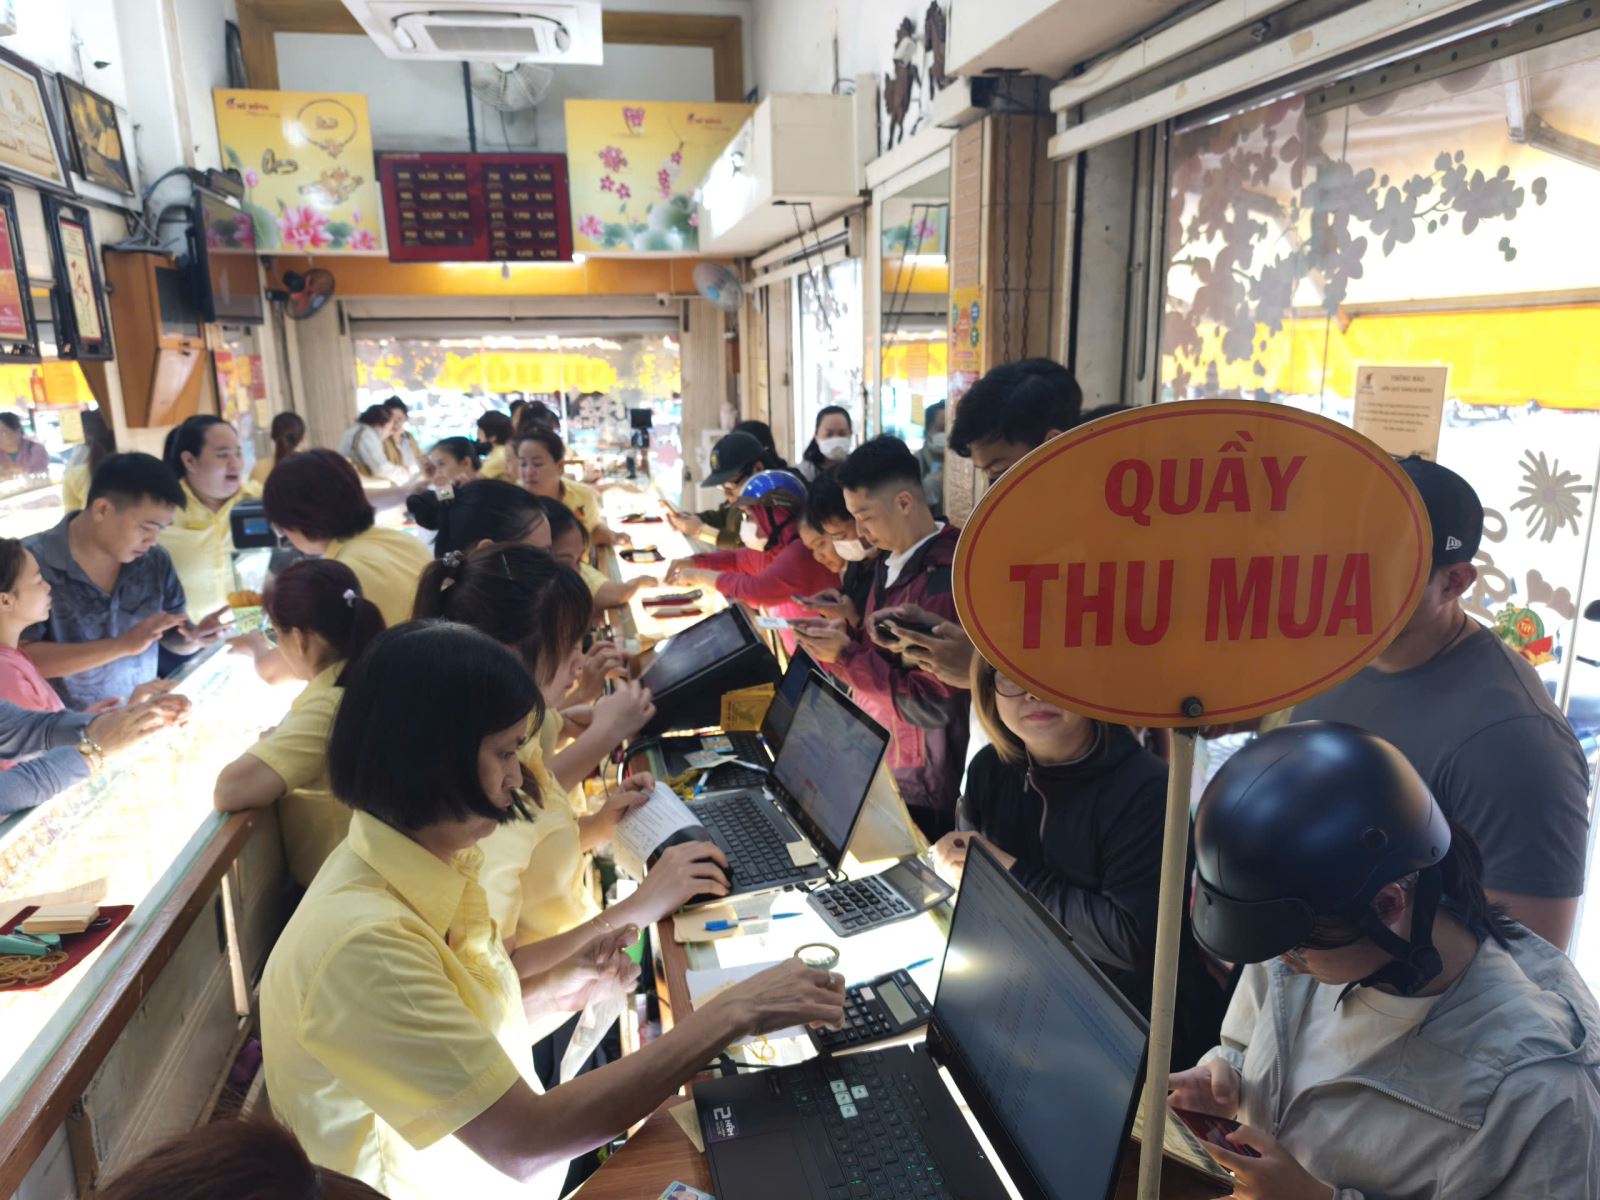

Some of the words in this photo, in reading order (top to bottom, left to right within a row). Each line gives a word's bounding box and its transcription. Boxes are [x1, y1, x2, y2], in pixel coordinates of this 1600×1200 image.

[1104, 430, 1307, 526] QUẦY
[1009, 559, 1174, 649] THU
[1204, 553, 1374, 642] MUA
